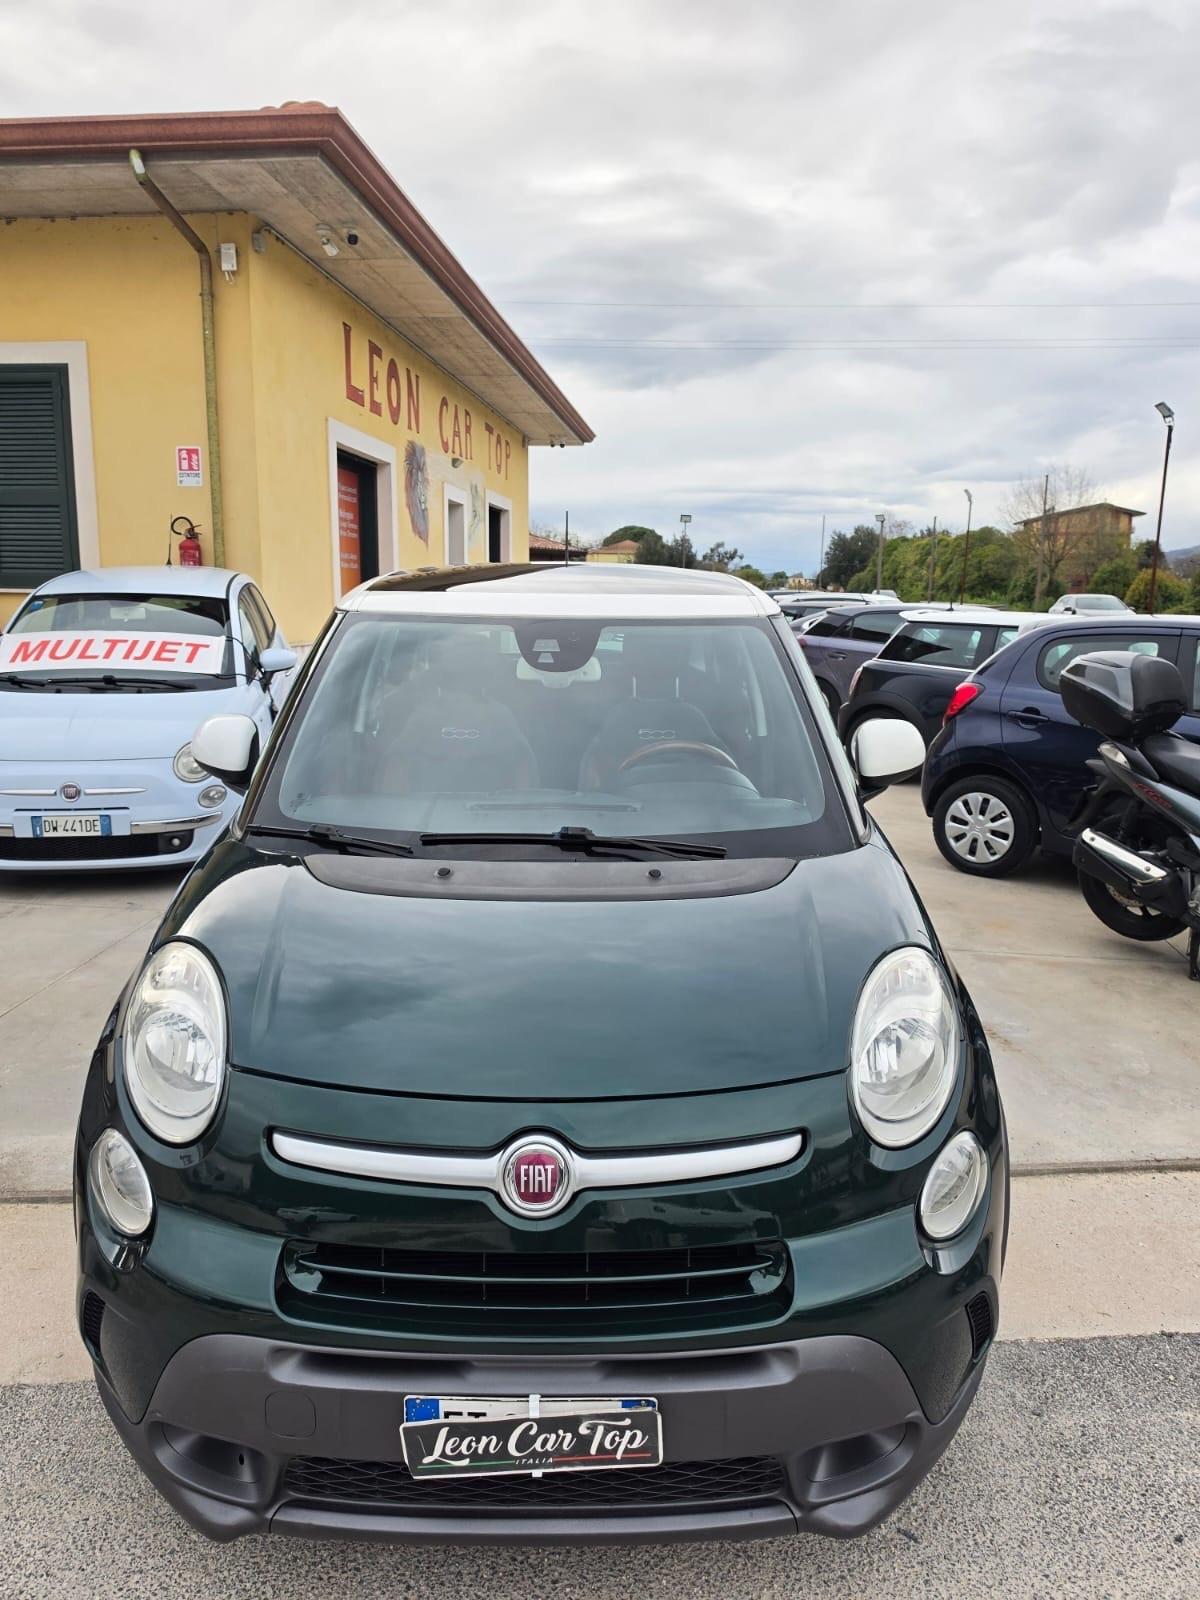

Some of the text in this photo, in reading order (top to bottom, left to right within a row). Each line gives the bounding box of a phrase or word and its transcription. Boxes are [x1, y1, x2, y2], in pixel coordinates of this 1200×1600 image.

[343, 321, 511, 480] LEON CAR TOP
[9, 638, 210, 664] MULTIJET
[520, 1164, 555, 1193] FIAT
[422, 1418, 649, 1466] Leon Car Top
[515, 1457, 554, 1465] ITALIA
